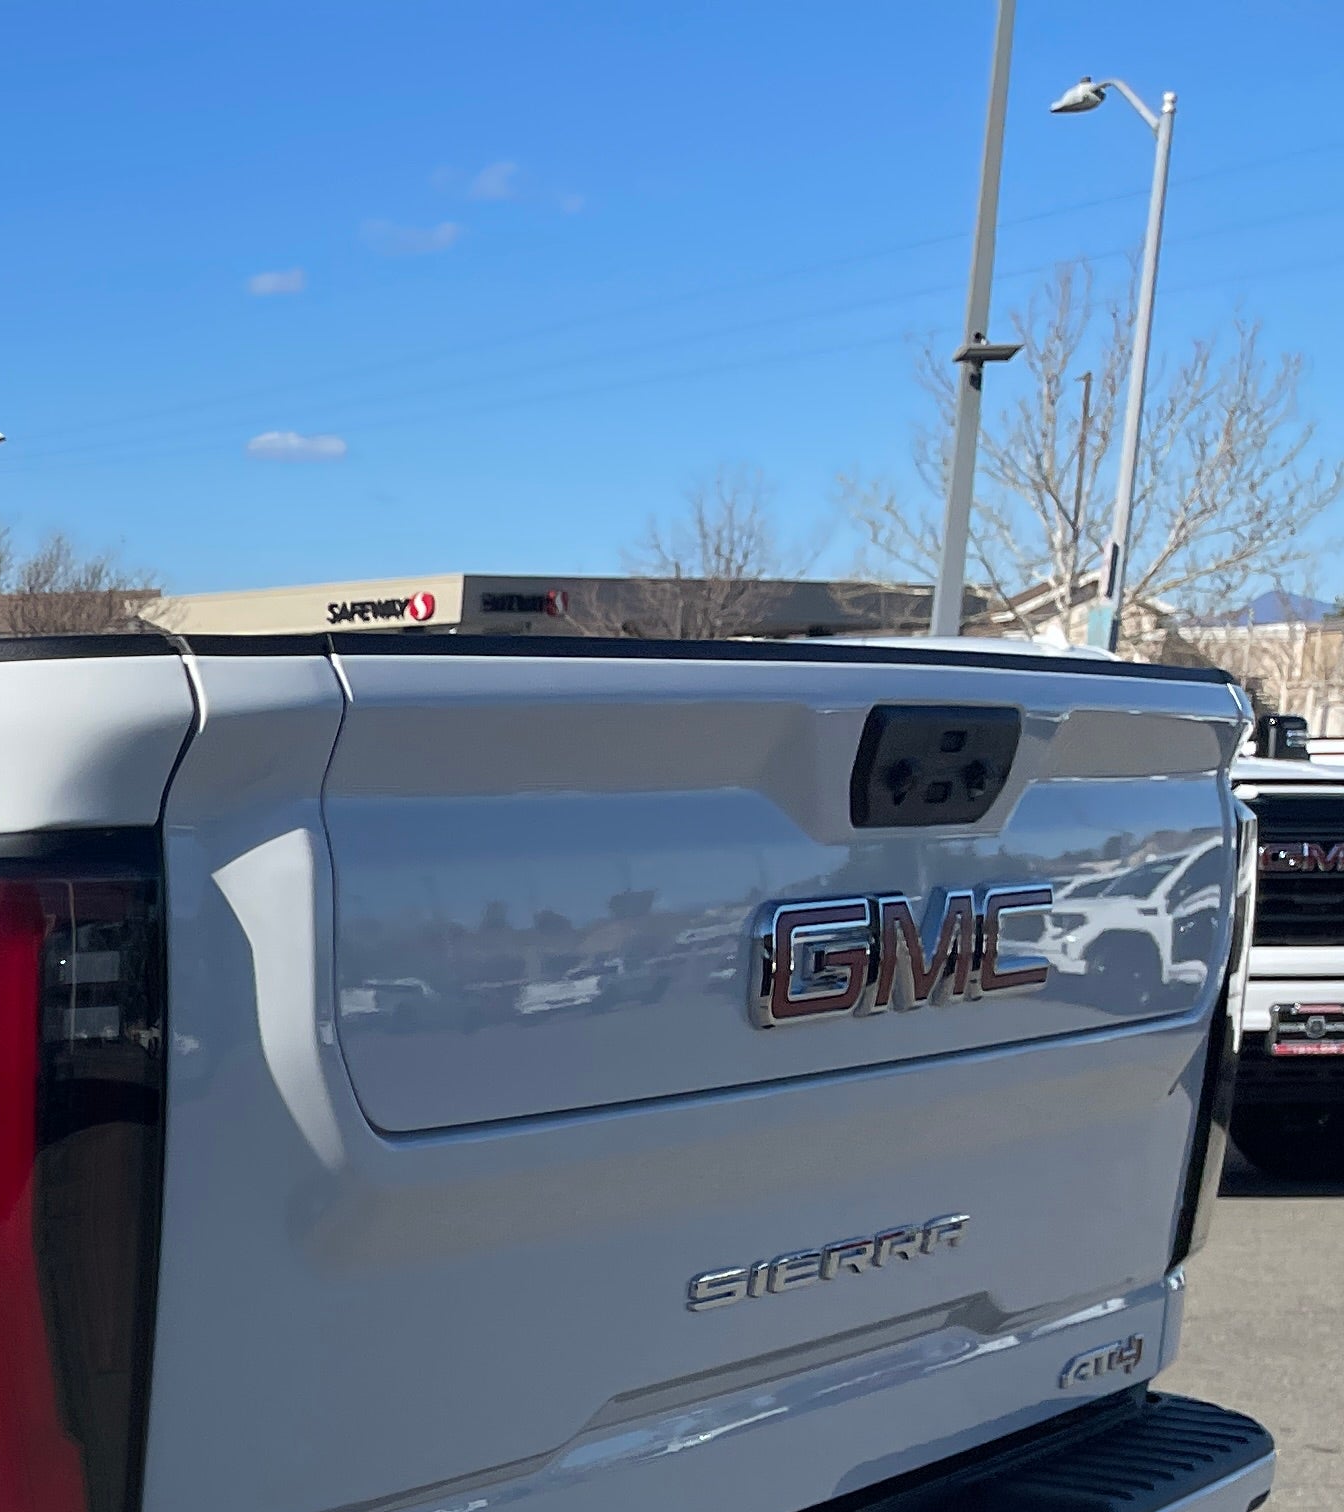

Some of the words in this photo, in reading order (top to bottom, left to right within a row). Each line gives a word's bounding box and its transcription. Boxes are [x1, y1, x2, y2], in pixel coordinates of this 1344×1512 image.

[327, 597, 410, 624] SAFEWAY
[752, 883, 1054, 1028] GMC
[687, 1213, 971, 1312] SIERRA
